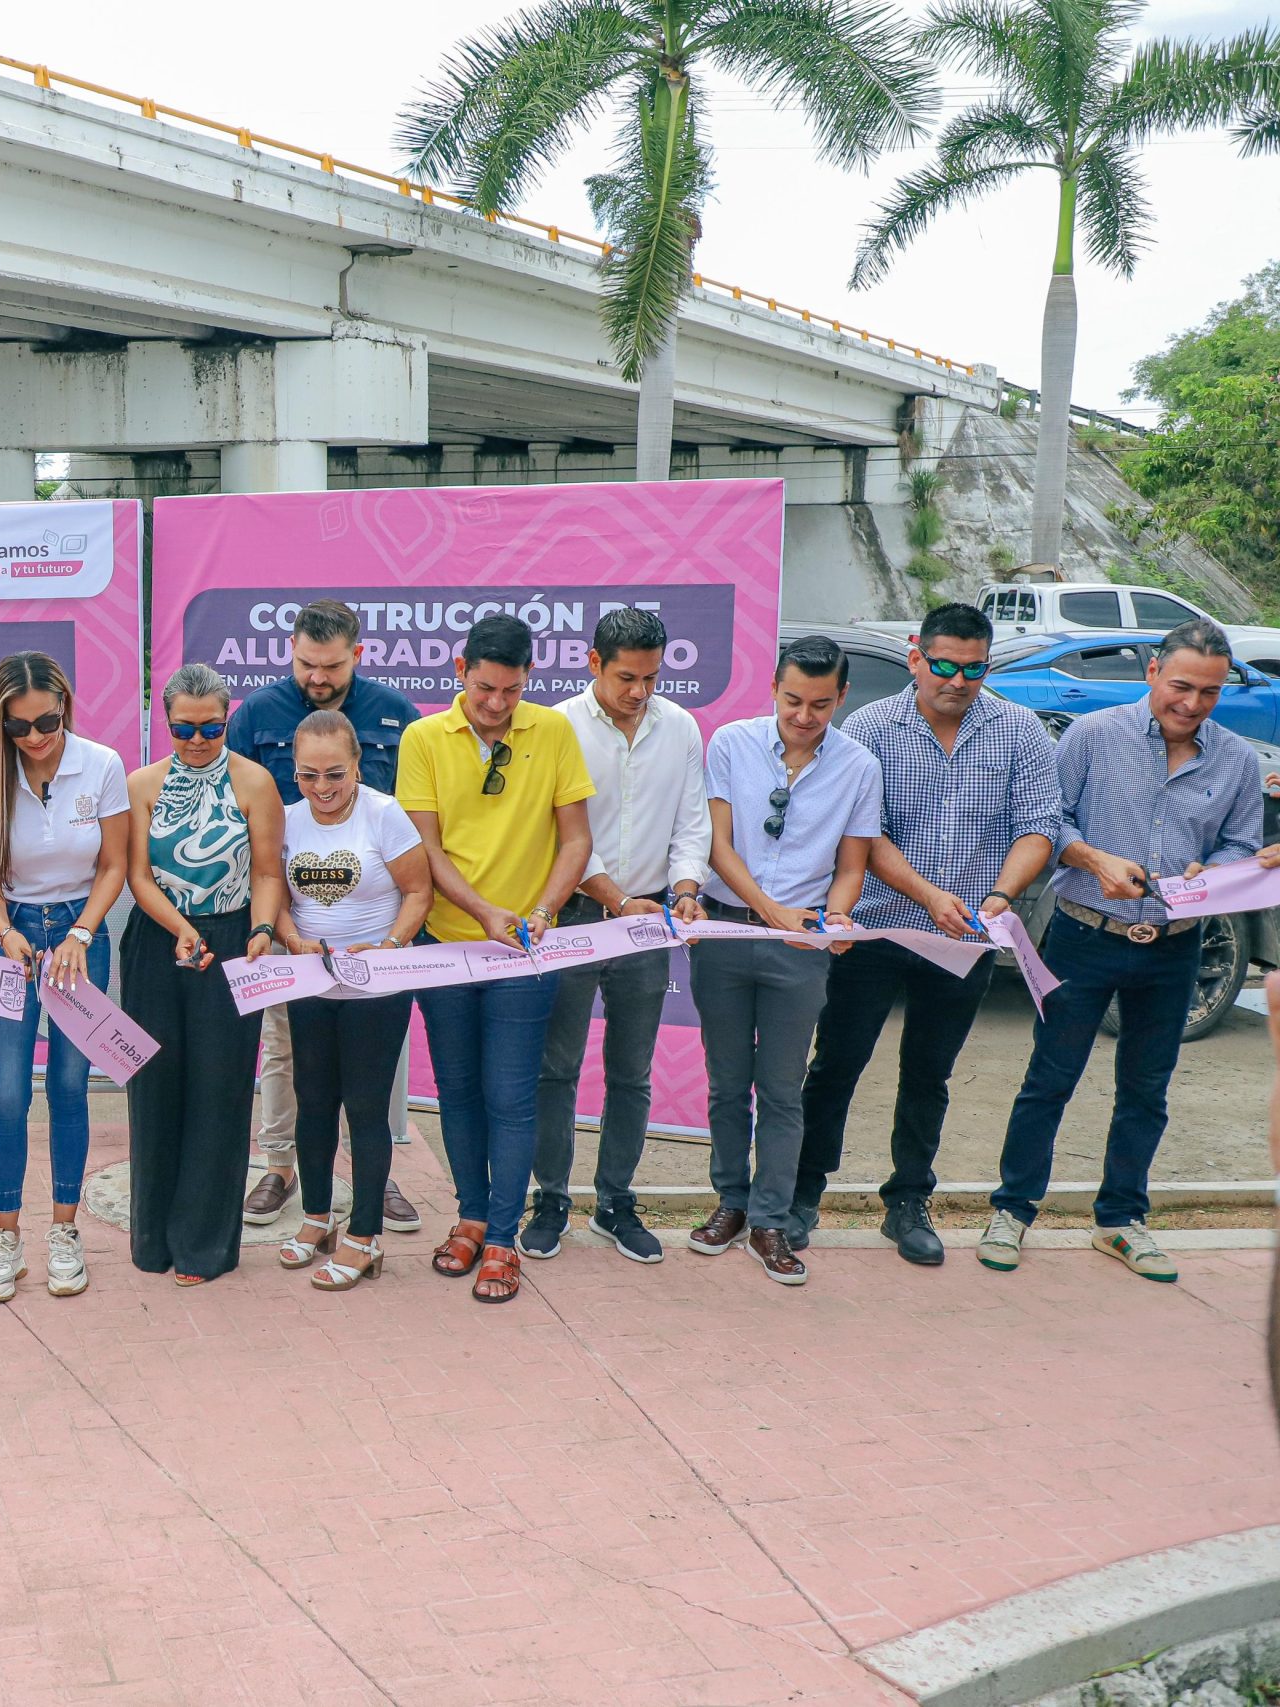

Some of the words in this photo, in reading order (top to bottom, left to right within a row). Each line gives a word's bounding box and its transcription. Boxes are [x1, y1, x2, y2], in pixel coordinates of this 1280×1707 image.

[13, 566, 21, 576] y
[23, 565, 35, 574] tu
[37, 564, 73, 574] futuro
[440, 677, 464, 690] DE
[654, 680, 700, 694] UJER
[300, 869, 345, 880] GUESS
[1170, 894, 1201, 903] futuro
[412, 962, 456, 970] BANDERAS
[486, 963, 500, 972] por
[503, 961, 513, 969] tu
[562, 949, 589, 957] futuro
[251, 986, 260, 994] tu
[261, 980, 289, 991] futuro
[66, 992, 94, 1020] BANDERAS
[99, 1042, 112, 1054] por
[111, 1051, 120, 1061] tu
